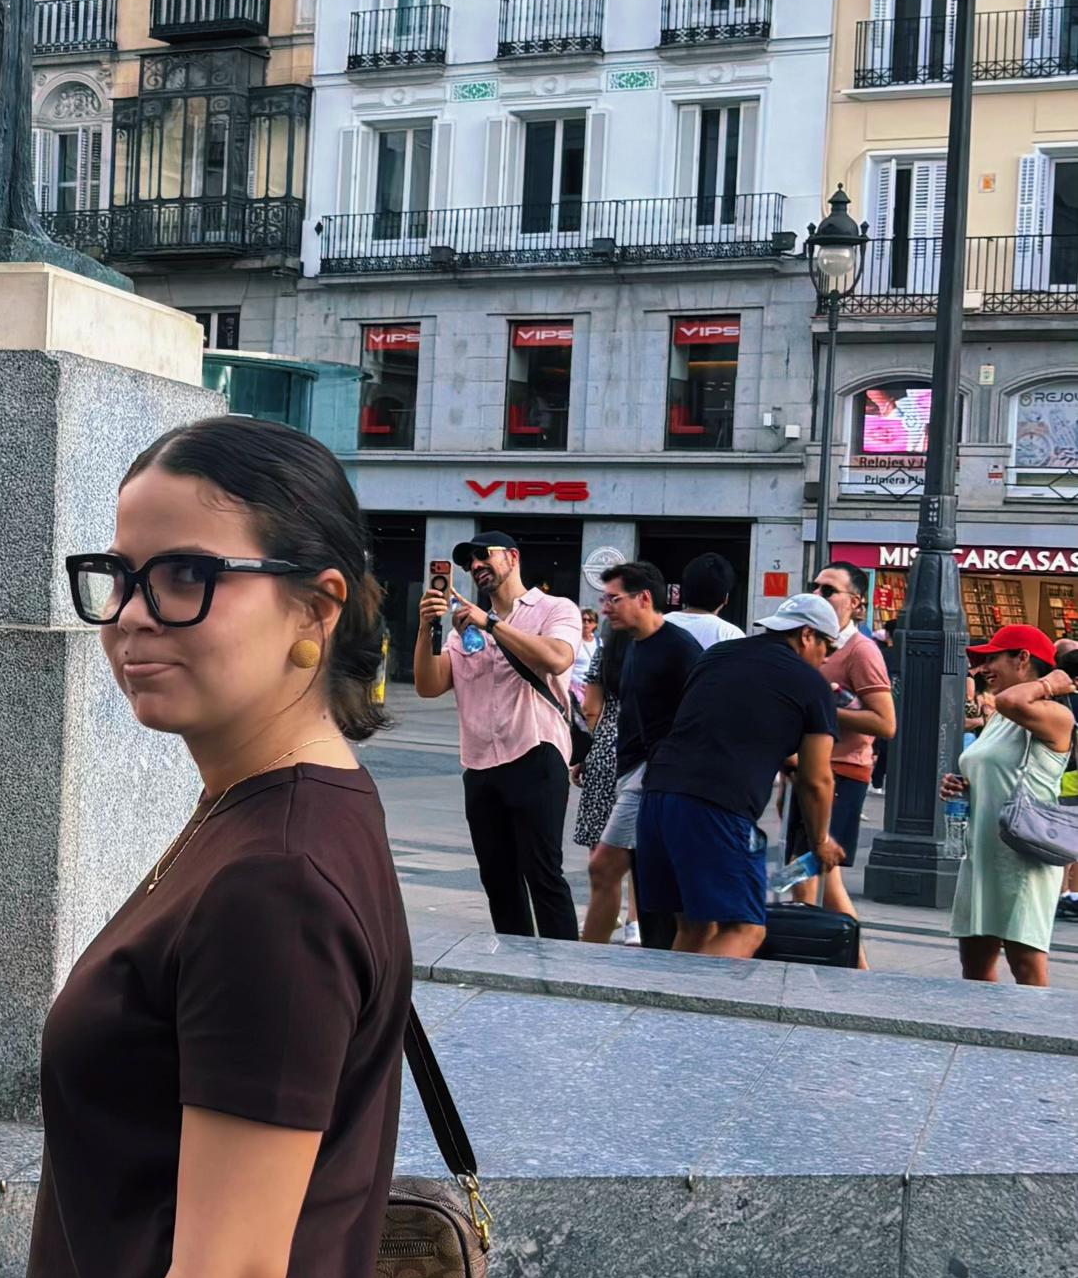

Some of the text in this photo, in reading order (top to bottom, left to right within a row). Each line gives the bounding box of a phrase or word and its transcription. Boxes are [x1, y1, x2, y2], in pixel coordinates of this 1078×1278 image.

[517, 329, 574, 341] VIPS
[679, 326, 741, 337] VIPS
[369, 332, 420, 344] VIPS
[859, 456, 904, 470] Relojes
[908, 459, 916, 470] y
[865, 474, 905, 485] Primera
[465, 479, 590, 502] VIPS
[773, 559, 781, 570] 3
